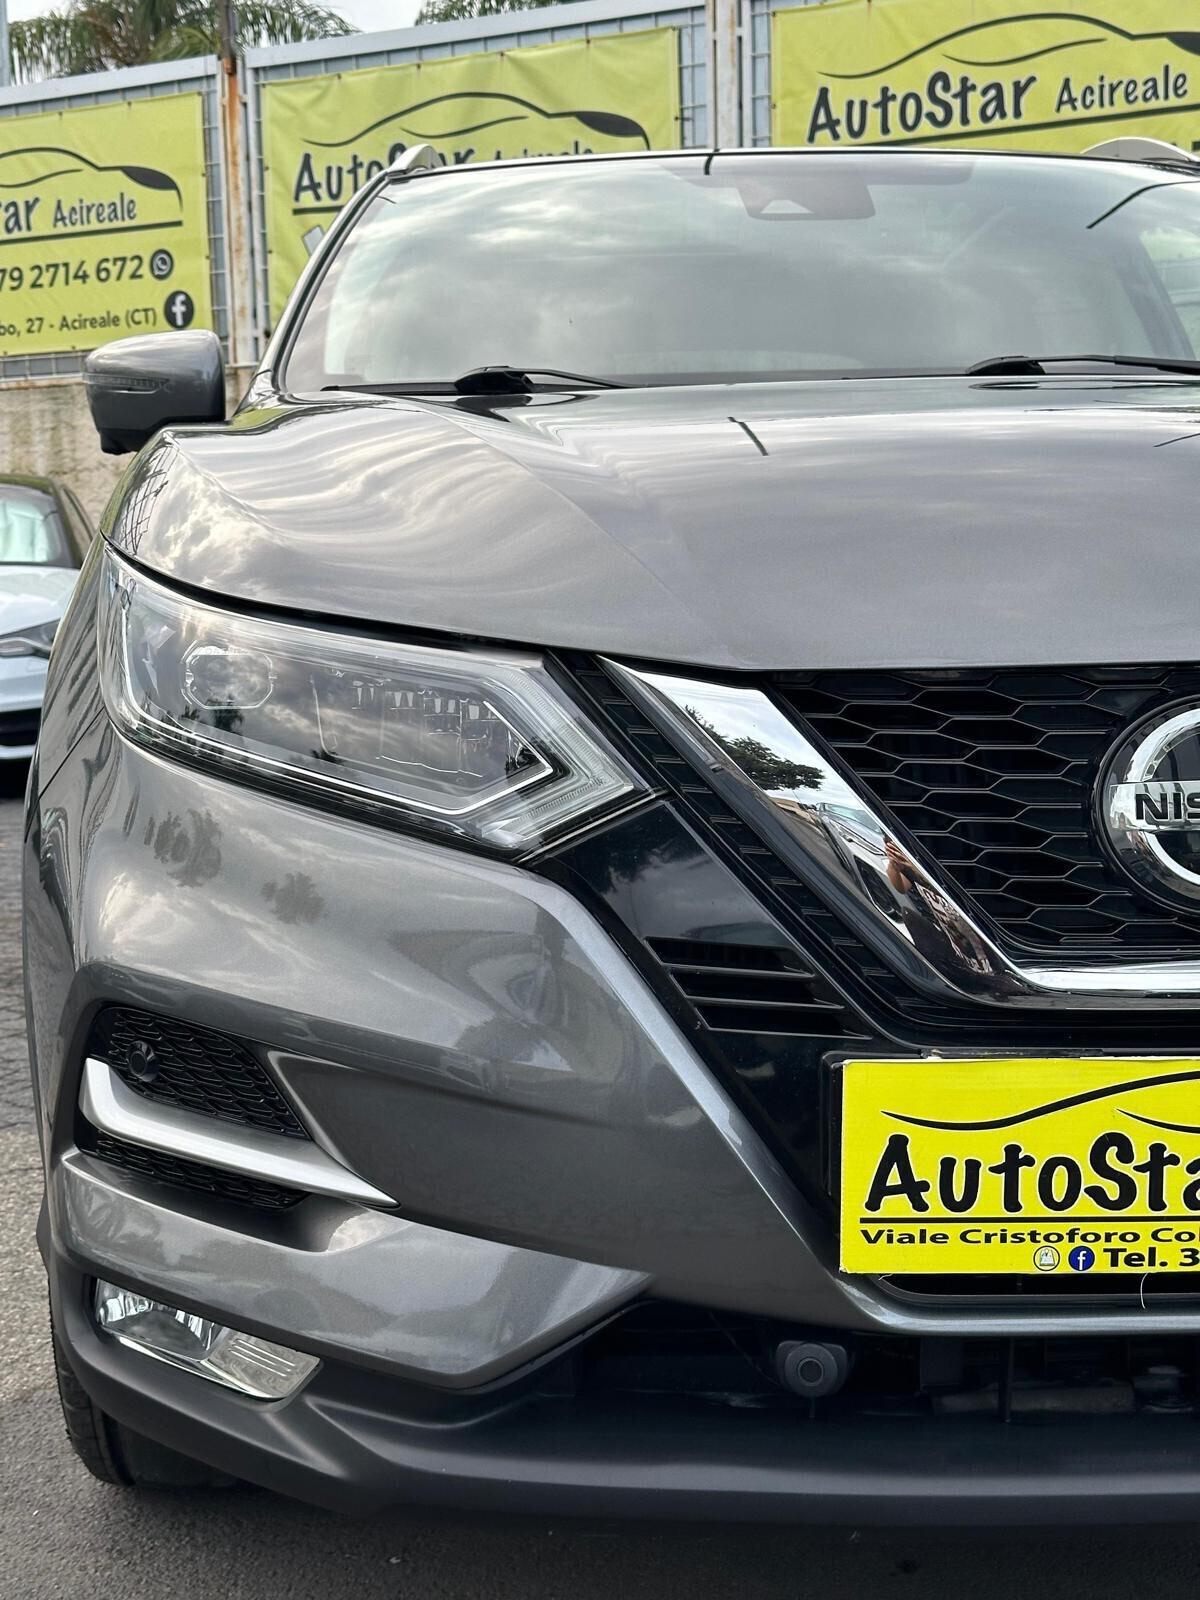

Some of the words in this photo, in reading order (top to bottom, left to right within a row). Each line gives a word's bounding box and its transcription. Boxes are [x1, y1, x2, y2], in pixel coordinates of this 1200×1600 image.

[807, 71, 1037, 143] AutoStar
[1056, 64, 1188, 113] Acireale
[293, 142, 475, 201] Auto
[0, 196, 40, 234] ar
[53, 192, 137, 228] Acireale
[30, 260, 89, 289] 2714
[96, 254, 144, 282] 672
[26, 317, 44, 334] 27
[59, 311, 121, 332] Acireale
[125, 307, 158, 327] (CT)
[859, 1228, 949, 1245] Viale
[959, 1227, 1141, 1244] Cristoforo
[1150, 1227, 1200, 1243] Co
[1102, 1247, 1168, 1268] Tel.
[1178, 1247, 1200, 1267] 3
